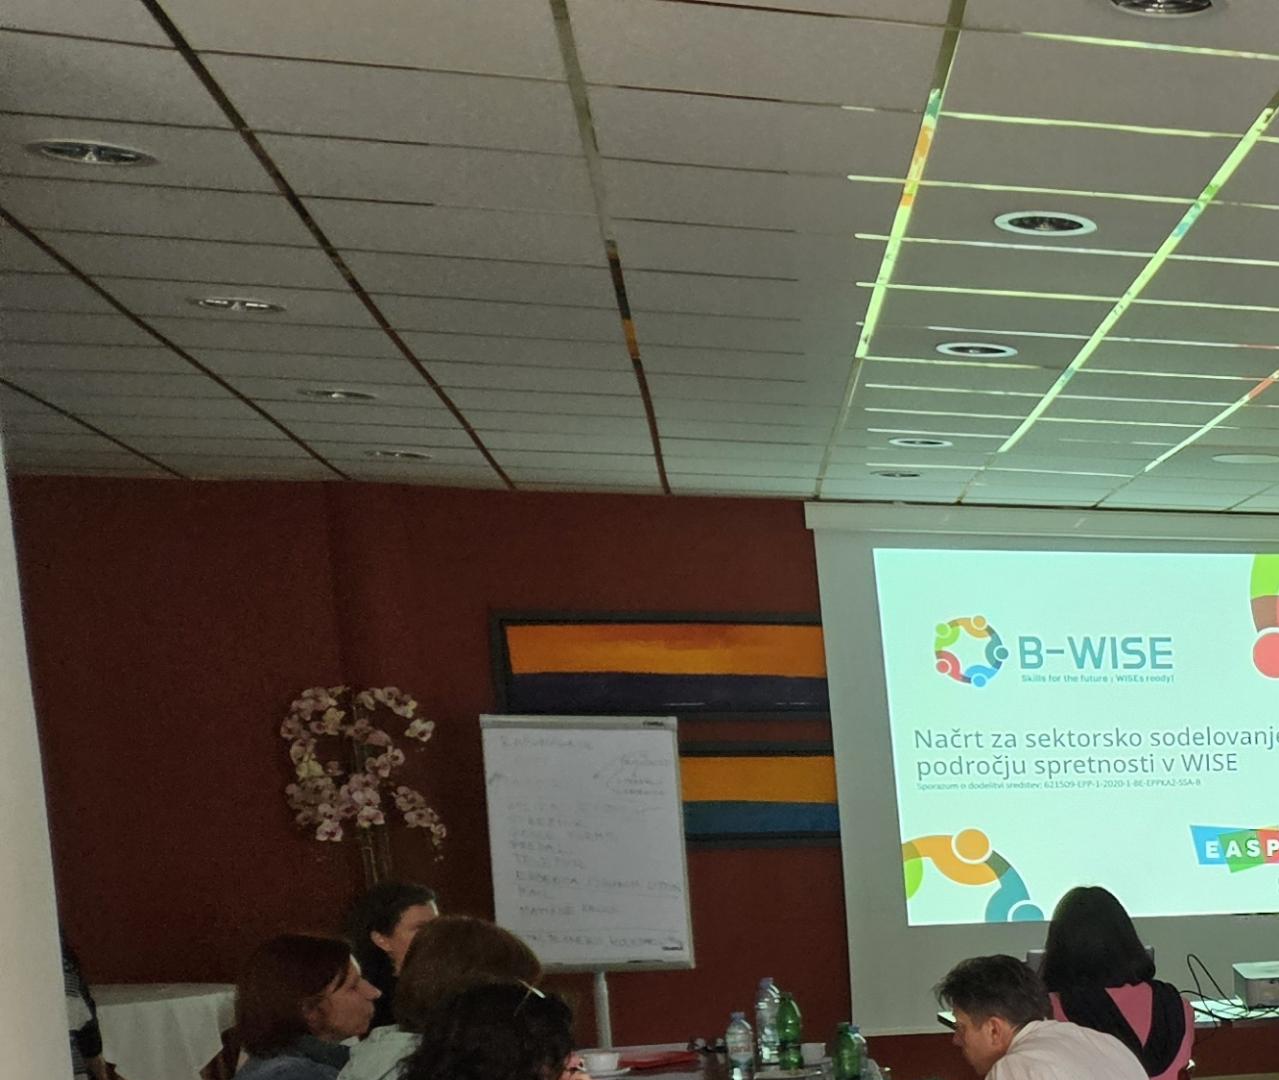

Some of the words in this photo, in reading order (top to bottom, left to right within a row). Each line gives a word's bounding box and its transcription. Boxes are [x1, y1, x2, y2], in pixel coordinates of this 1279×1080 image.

[1018, 635, 1174, 670] B-WISE
[1049, 674, 1061, 683] for
[1063, 674, 1079, 683] the
[1080, 674, 1109, 683] future
[914, 728, 985, 749] Načrt
[991, 732, 1017, 749] za
[1025, 727, 1142, 748] sektorsko
[917, 754, 1026, 781] področju
[1034, 754, 1154, 780] spretnosti
[1162, 757, 1175, 772] v
[1180, 753, 1238, 772] WISE
